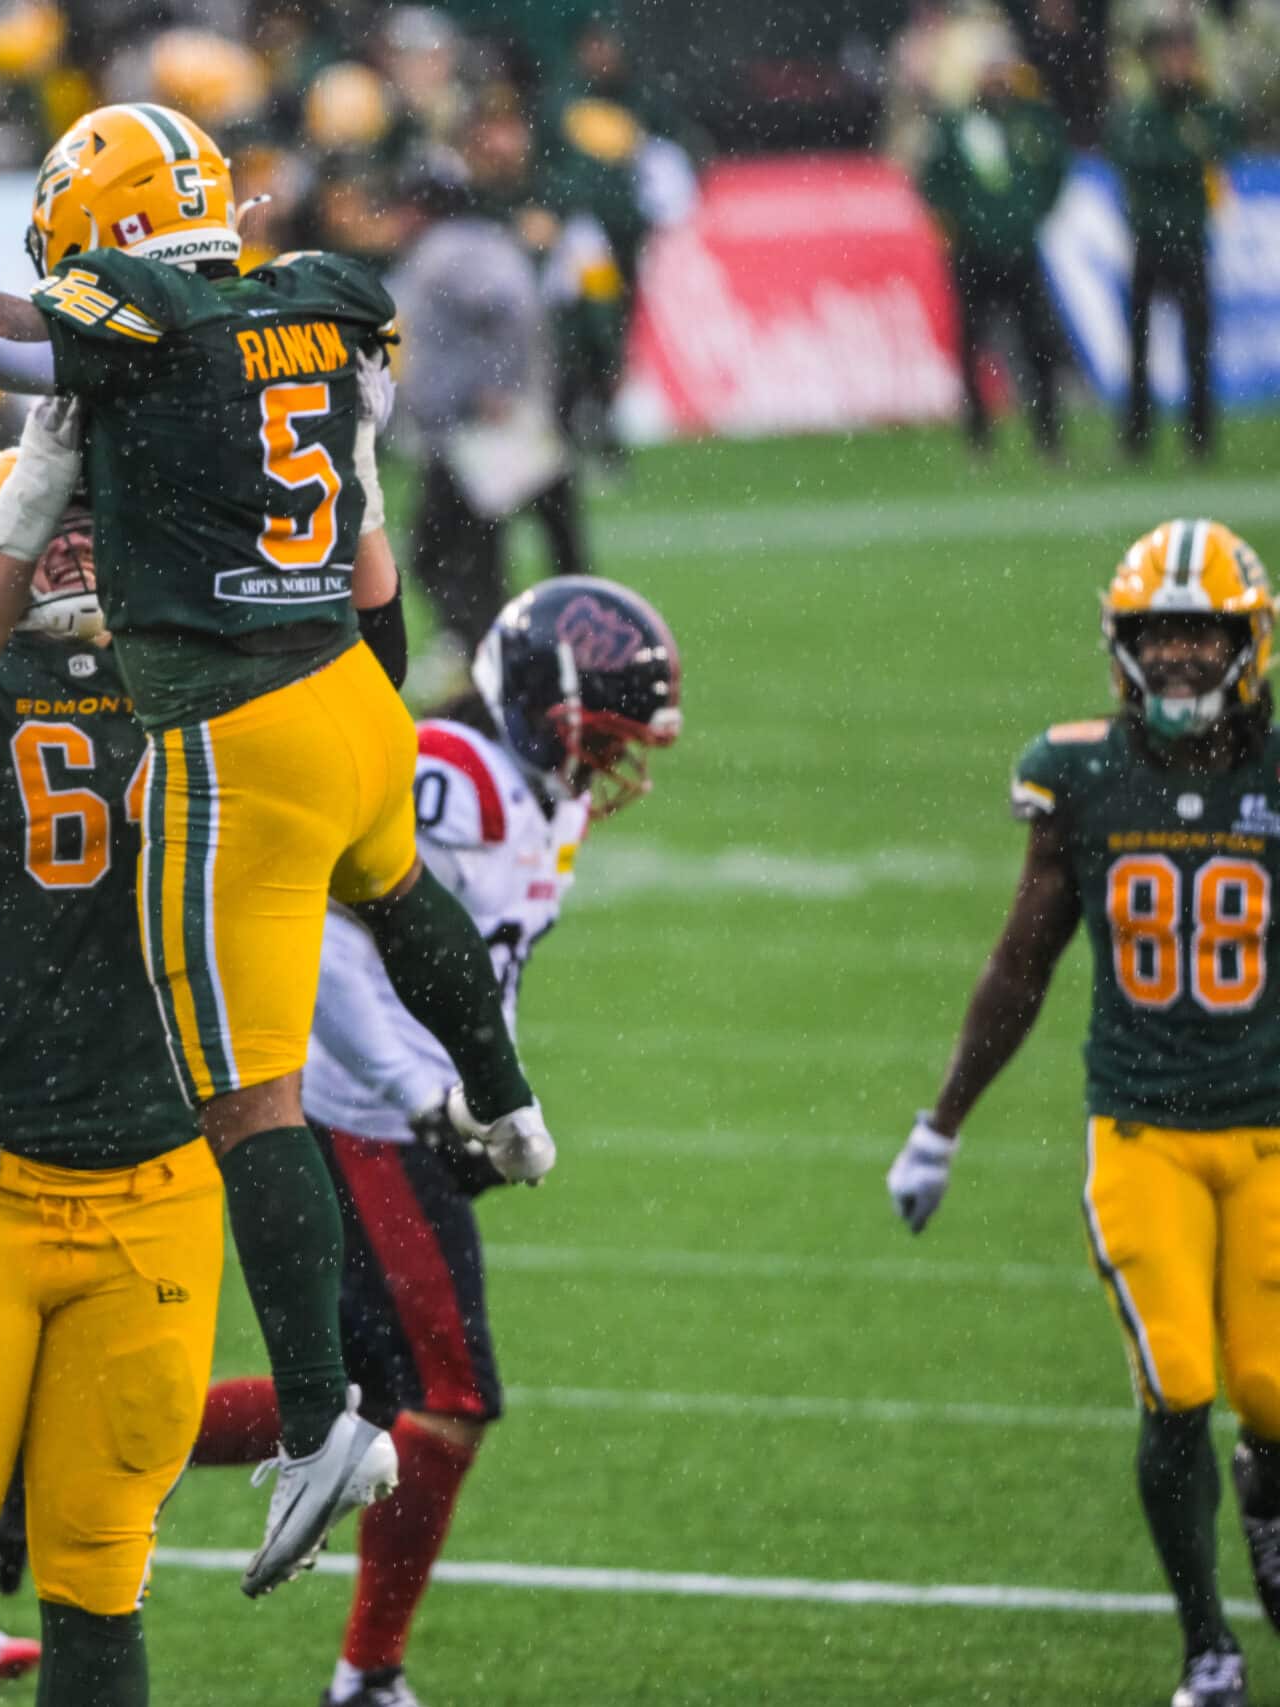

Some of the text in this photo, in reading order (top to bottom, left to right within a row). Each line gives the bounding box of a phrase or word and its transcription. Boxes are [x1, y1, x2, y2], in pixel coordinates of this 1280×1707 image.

[171, 165, 206, 219] 5
[144, 239, 240, 260] DMONTON
[236, 321, 348, 381] RANKIN
[257, 382, 342, 570] 5
[281, 577, 320, 593] NORTH
[1106, 853, 1271, 1014] 88
